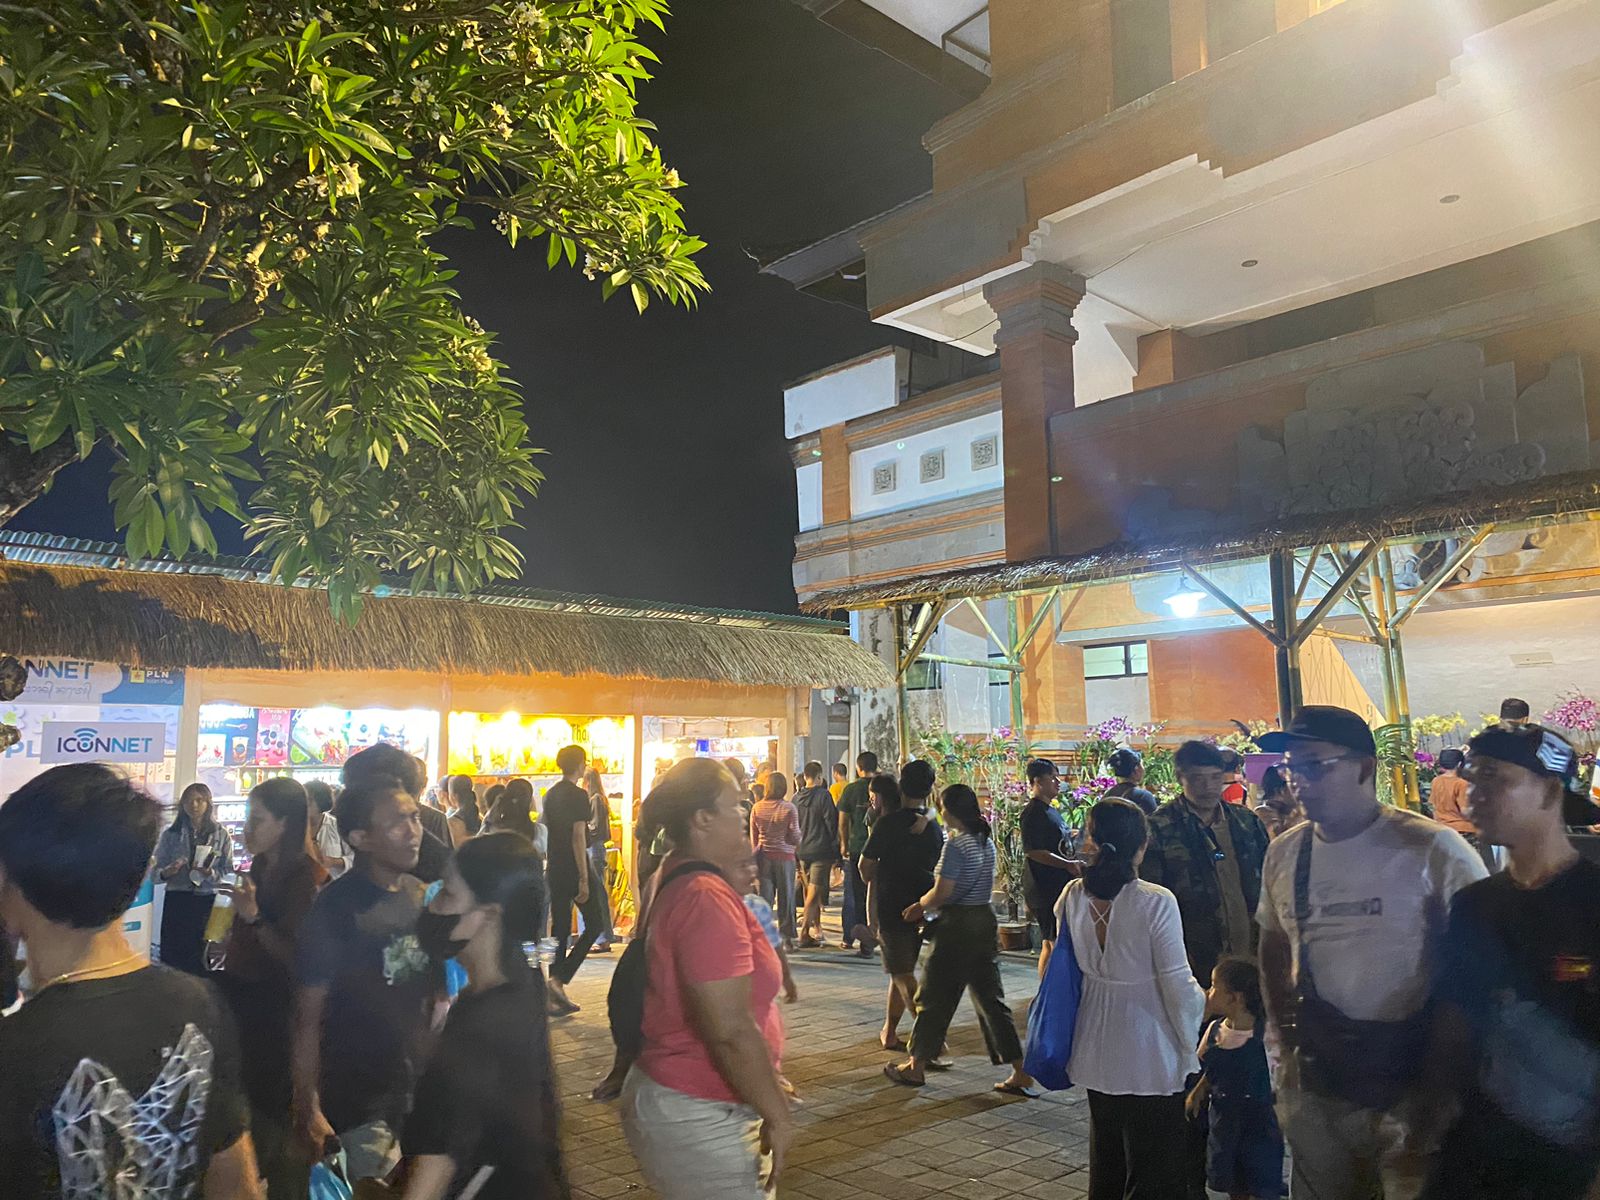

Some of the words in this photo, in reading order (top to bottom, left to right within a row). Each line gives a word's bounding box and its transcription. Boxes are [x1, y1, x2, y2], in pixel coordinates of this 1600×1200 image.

[25, 659, 94, 680] NNET
[146, 670, 169, 678] PLN
[5, 740, 41, 758] PL
[57, 737, 153, 753] ICONNET
